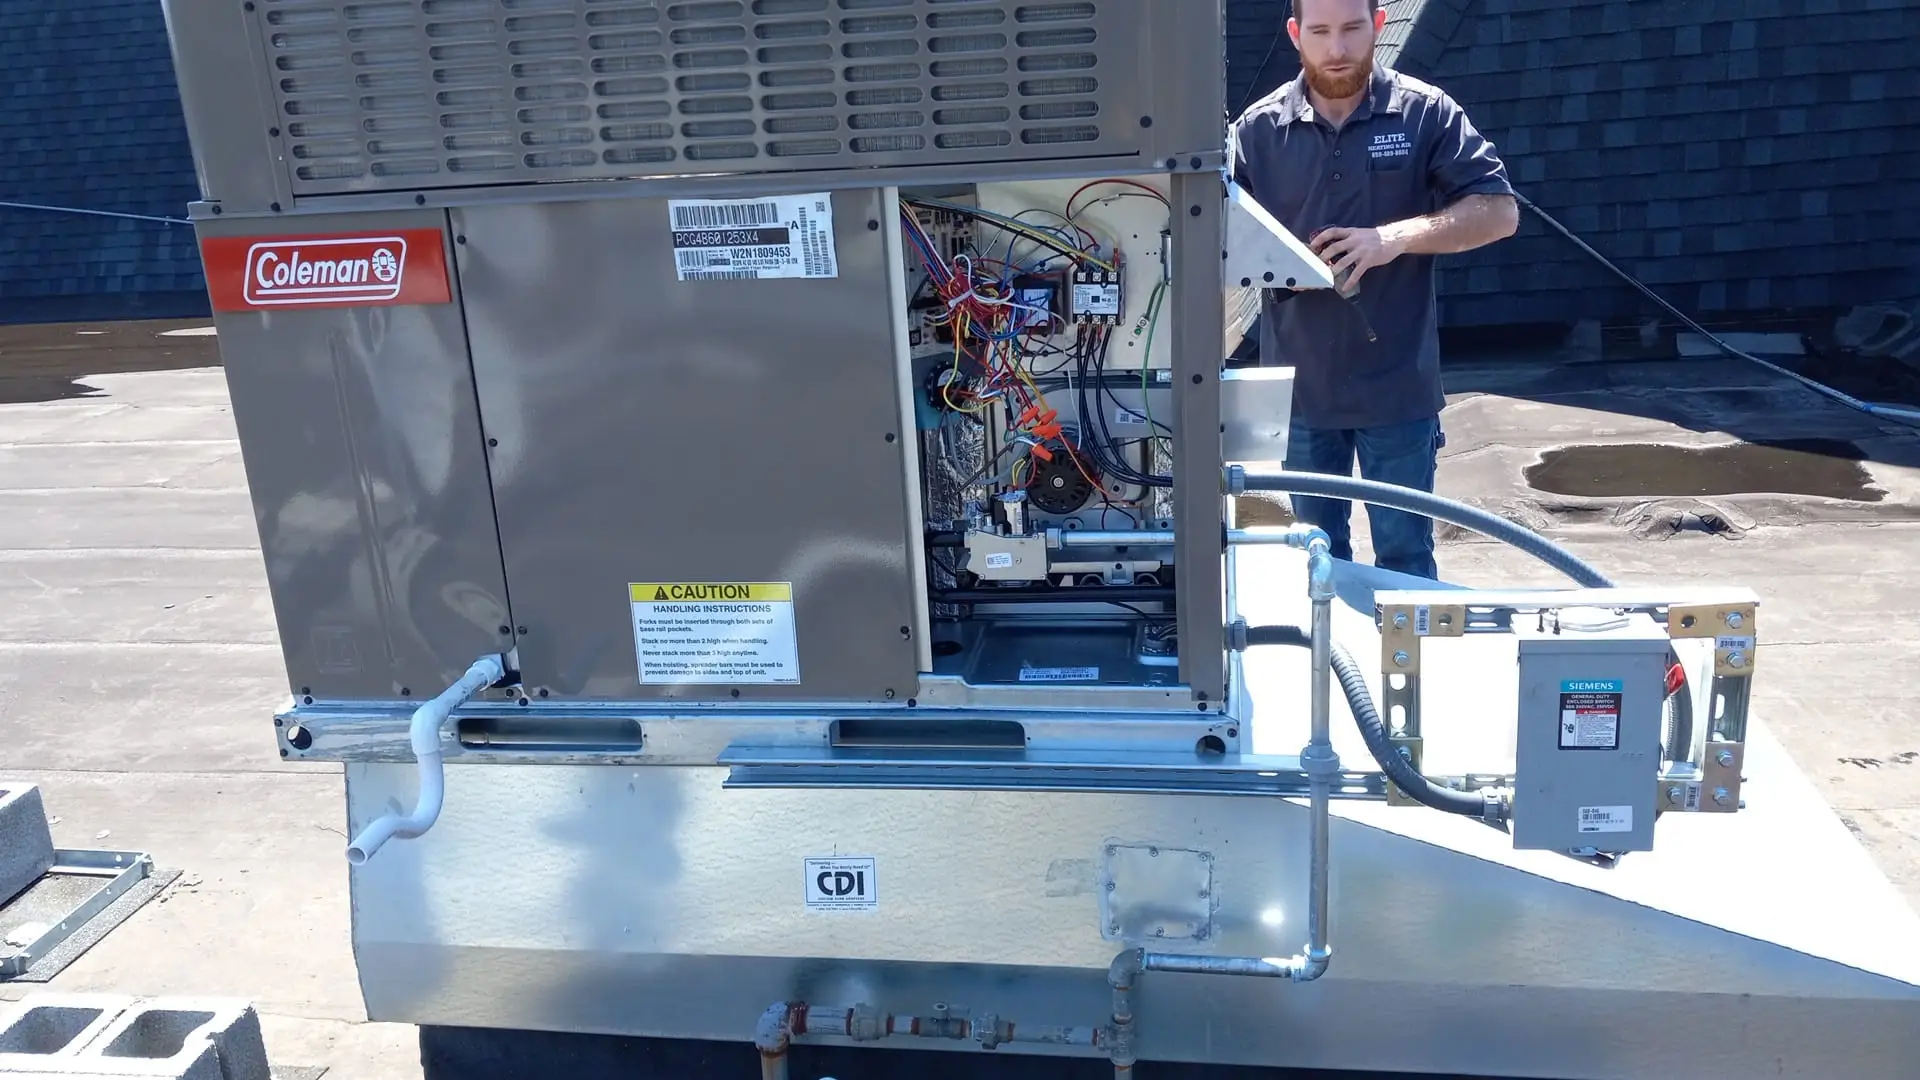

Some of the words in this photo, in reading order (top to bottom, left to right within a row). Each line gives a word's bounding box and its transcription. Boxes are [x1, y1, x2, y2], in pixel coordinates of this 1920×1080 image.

[1374, 133, 1405, 144] ELITE
[790, 221, 799, 230] A
[731, 247, 791, 259] W2N1809453
[256, 251, 369, 288] Coleman
[671, 585, 750, 599] CAUTION
[817, 871, 864, 896] CDI
